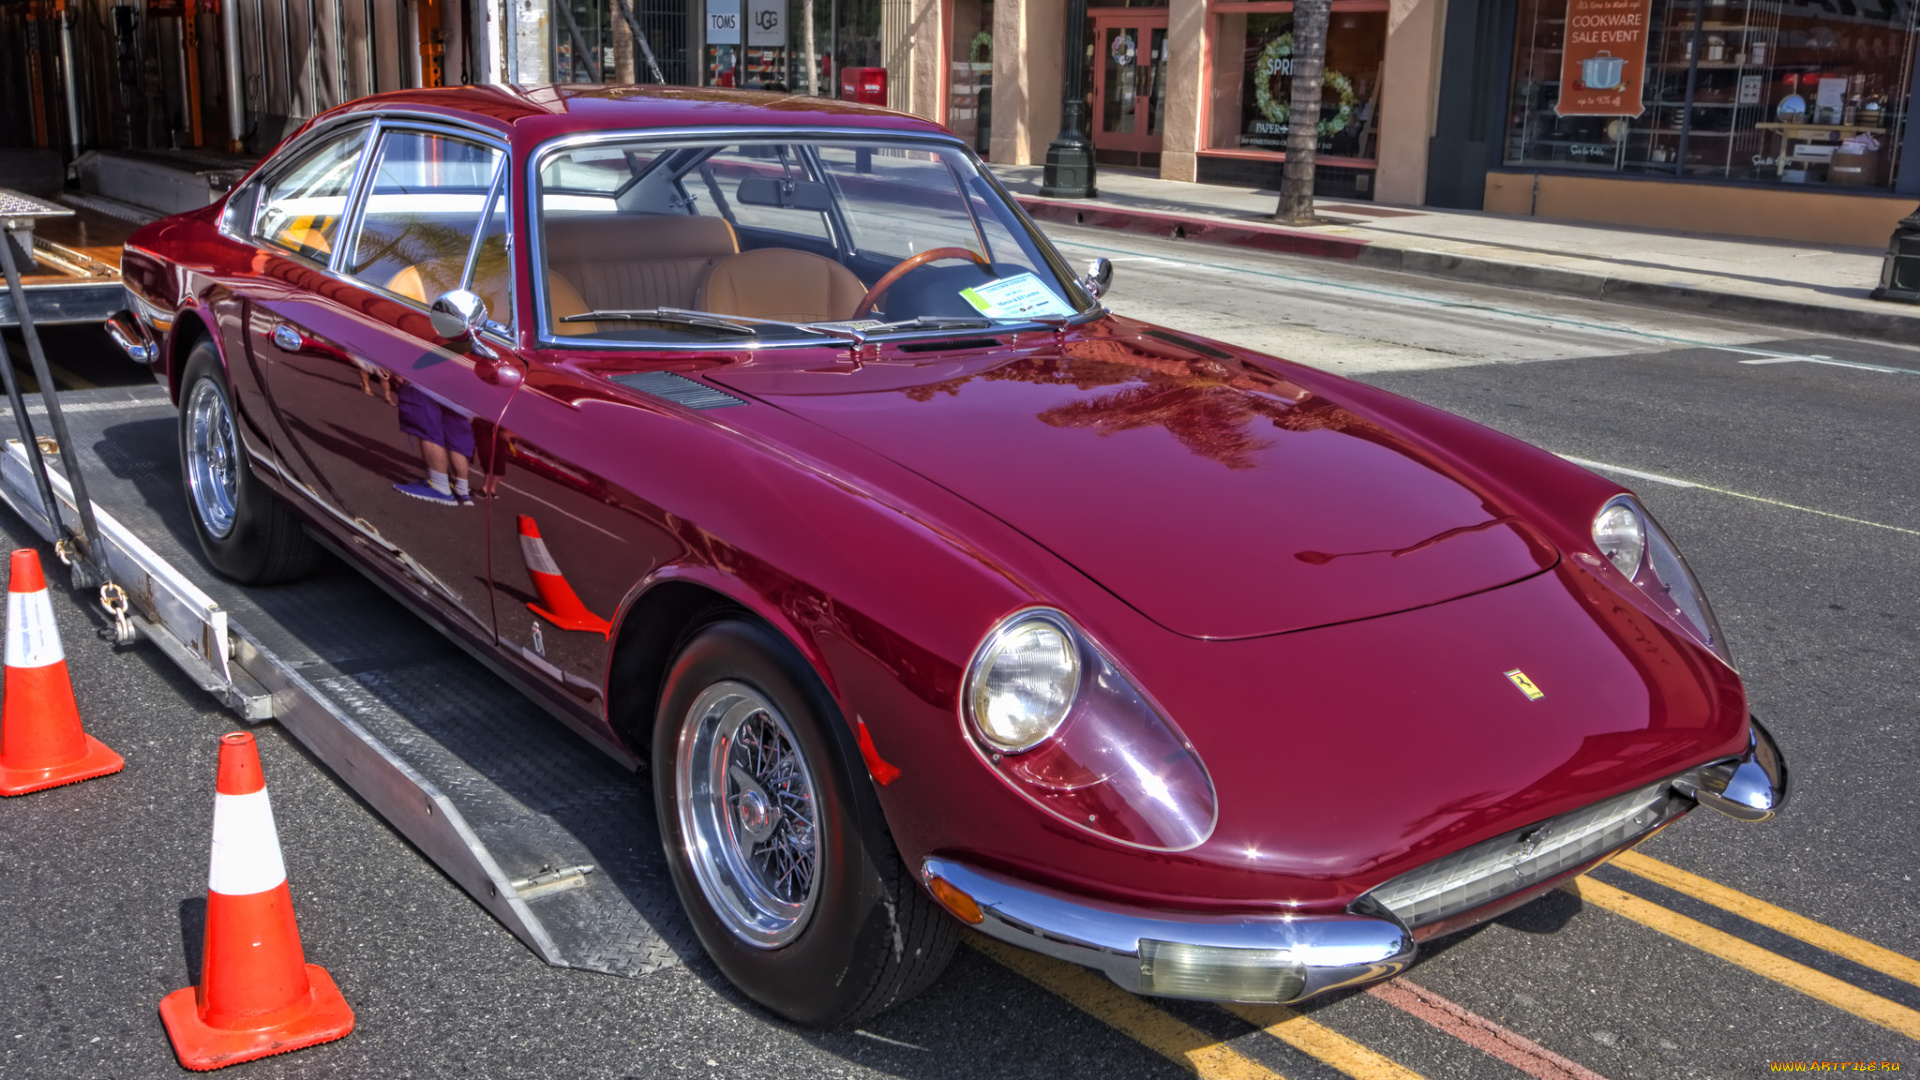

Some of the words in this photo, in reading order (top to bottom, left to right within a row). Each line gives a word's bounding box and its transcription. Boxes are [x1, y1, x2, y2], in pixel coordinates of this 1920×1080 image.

[1613, 0, 1628, 8] stock
[711, 15, 736, 29] TOMS
[755, 10, 778, 30] UGG
[1572, 14, 1642, 27] COOKWARE
[1572, 31, 1600, 43] SALE
[1601, 30, 1640, 43] EVENT
[1266, 58, 1293, 76] SPRI
[1577, 99, 1587, 107] up
[1612, 95, 1621, 107] off
[1255, 123, 1280, 134] PAPER
